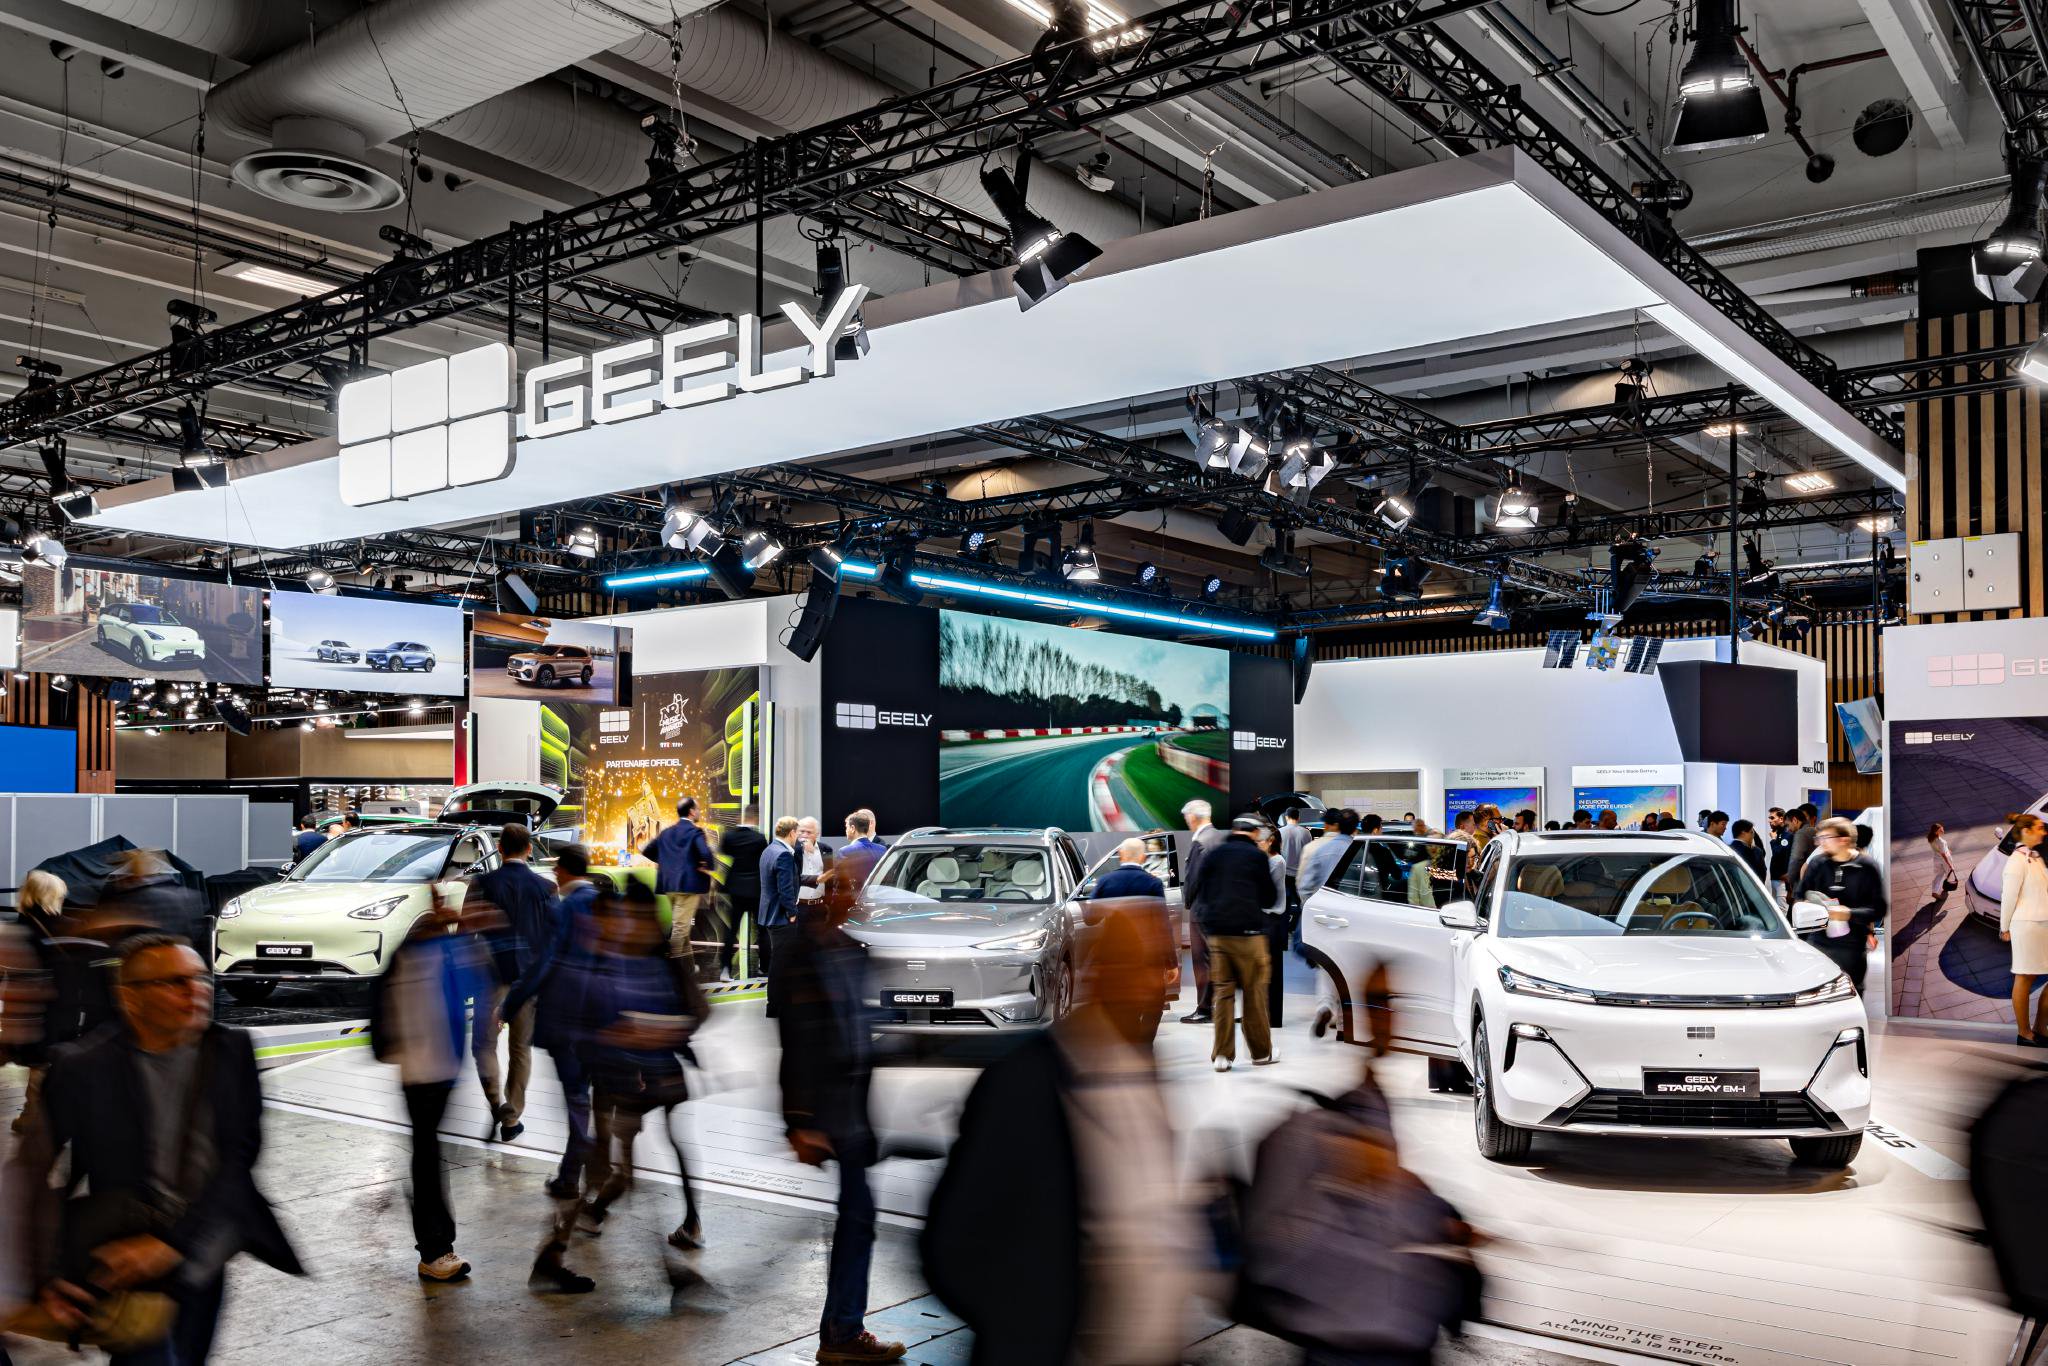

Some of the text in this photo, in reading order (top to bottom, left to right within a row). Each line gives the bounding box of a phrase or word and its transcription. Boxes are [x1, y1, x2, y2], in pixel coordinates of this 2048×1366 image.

[525, 284, 871, 440] GEELY
[878, 711, 933, 727] GEELY
[599, 735, 630, 744] GEELY
[1934, 733, 1975, 741] GEELY
[1256, 737, 1287, 748] GEELY
[605, 759, 682, 768] PARTENAIRE OFFICIEL
[265, 947, 291, 955] GEELY
[893, 994, 940, 1003] GEELY E5
[1684, 1075, 1718, 1084] GEELY
[1657, 1084, 1721, 1093] STARRAY
[1570, 1318, 1723, 1351] MIND THE STEP
[1539, 1321, 1740, 1364] Attention à la marche.
